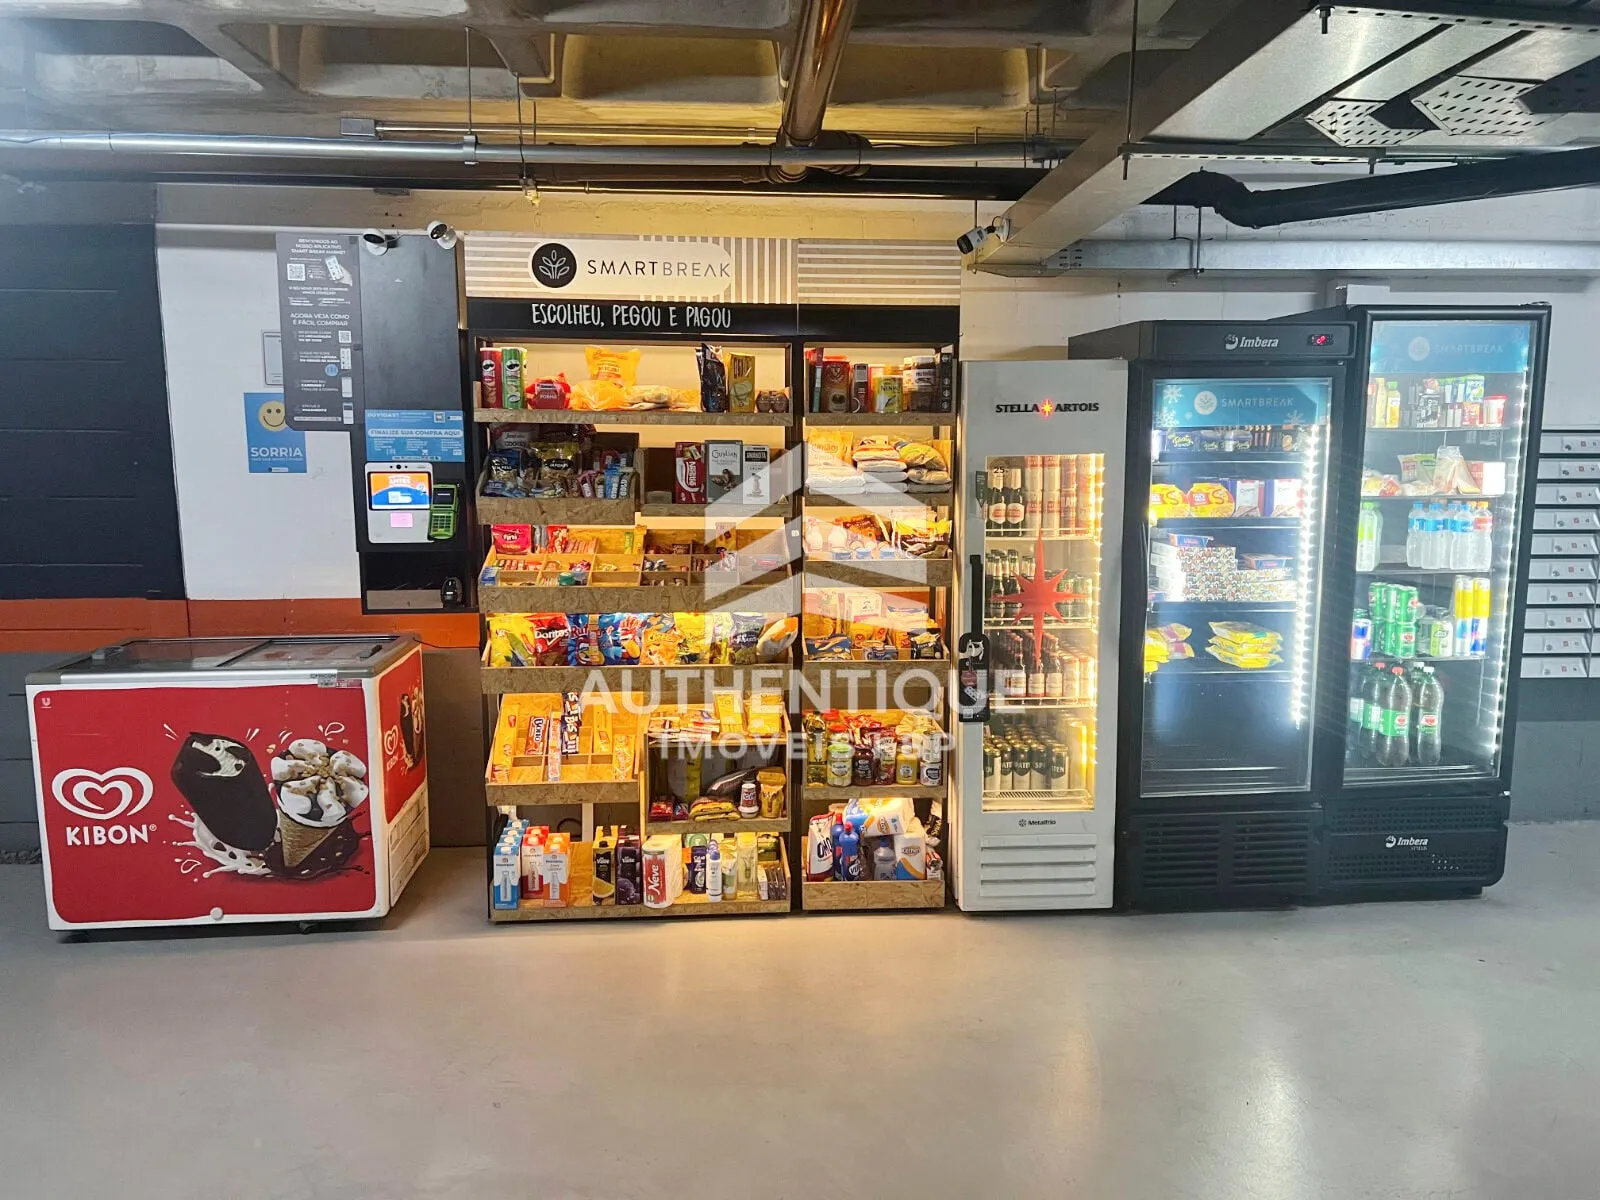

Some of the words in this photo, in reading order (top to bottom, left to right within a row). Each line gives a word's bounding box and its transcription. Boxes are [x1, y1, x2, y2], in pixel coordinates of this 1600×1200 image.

[587, 259, 731, 278] SMARTBREAK
[531, 303, 606, 327] ESCOLHEU,
[612, 305, 662, 327] PEGOU
[669, 306, 678, 327] E
[686, 306, 732, 329] PAGOU
[1239, 336, 1279, 348] Imbera
[995, 404, 1040, 413] STELLA
[1055, 402, 1100, 412] ARTOIS
[250, 447, 303, 457] SORRIA
[534, 629, 568, 640] Doritos
[65, 824, 149, 846] KIBON
[1397, 836, 1428, 846] Imbera
[648, 864, 661, 896] Neve
